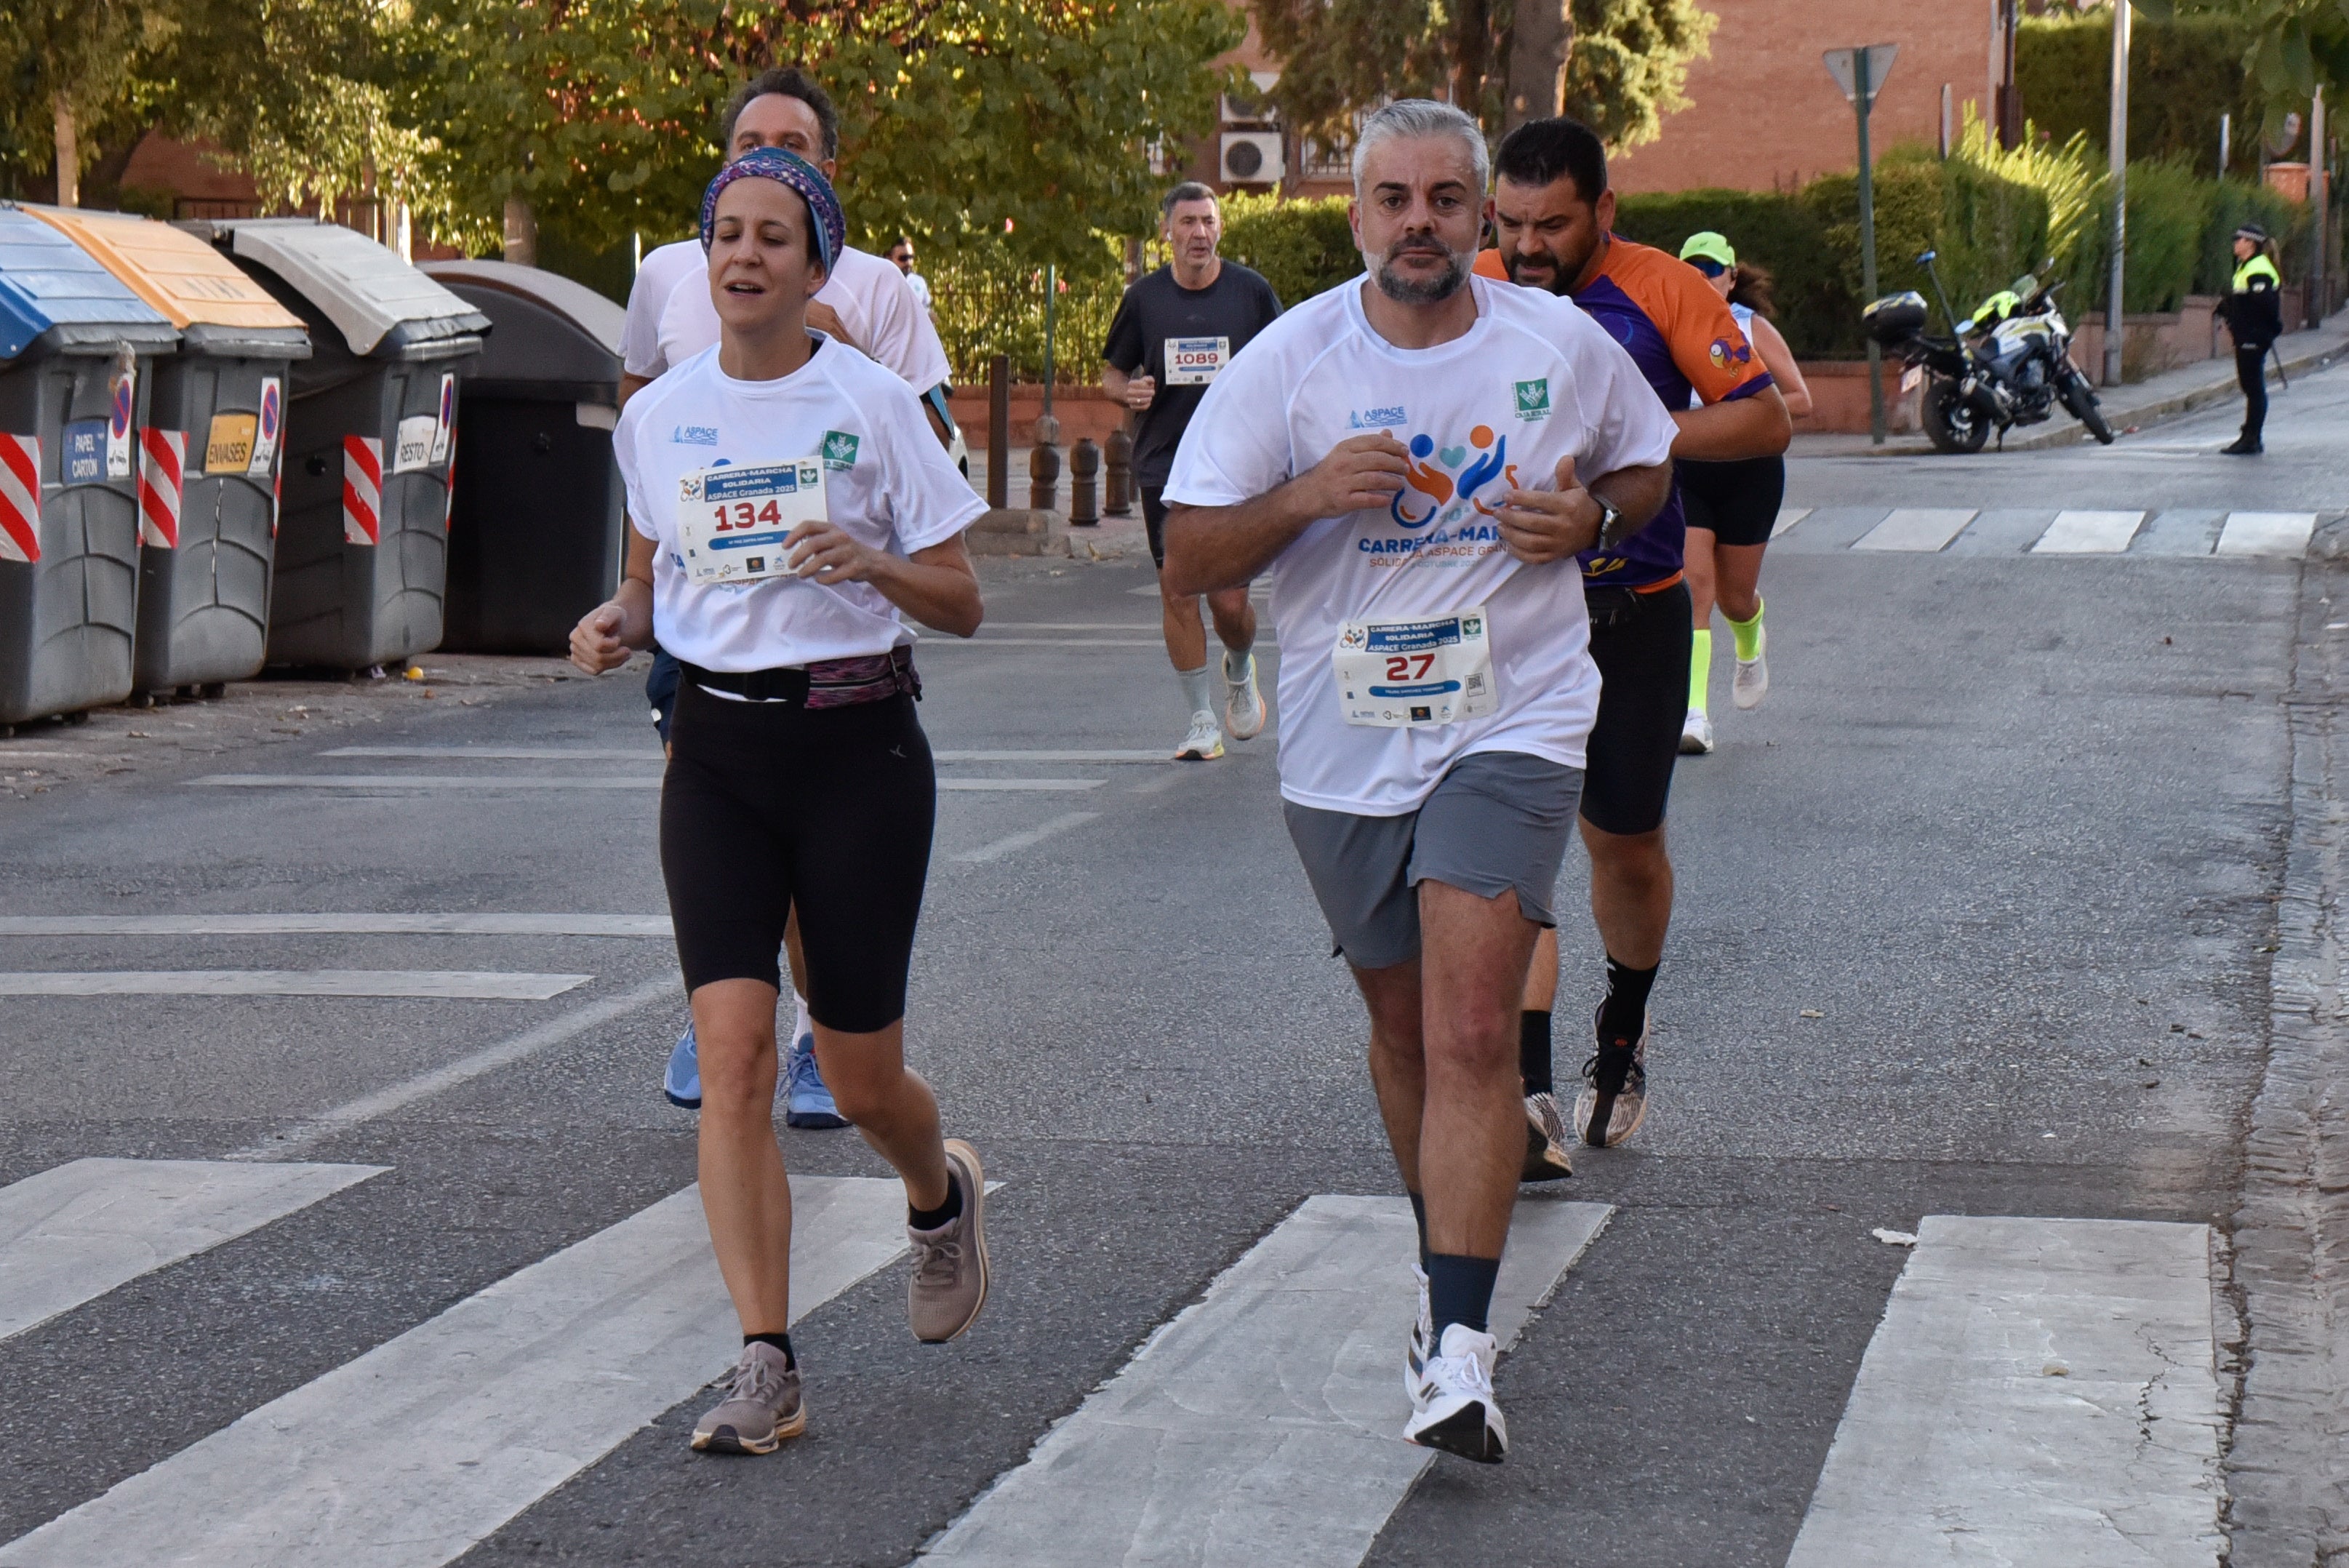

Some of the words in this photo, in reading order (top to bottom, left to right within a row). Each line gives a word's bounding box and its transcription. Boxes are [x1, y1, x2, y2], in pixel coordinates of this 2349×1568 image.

[1175, 353, 1218, 364] 1089
[1364, 407, 1404, 420] ASPACE
[684, 426, 718, 438] ASPACE
[75, 434, 95, 452] PAPEL
[209, 442, 247, 463] ENVASES
[401, 441, 424, 463] RESTO
[72, 454, 97, 478] CARTÓN
[707, 467, 793, 481] CARRERA-MARCHA
[722, 478, 772, 488] SOLIDARIA
[708, 489, 737, 500] ASPACE
[740, 486, 773, 496] Granada
[775, 484, 795, 493] 2025
[714, 500, 782, 532] 134
[1428, 547, 1473, 556] ASPACE
[1370, 620, 1455, 632] CARRERA-MARCHA
[1385, 632, 1434, 641] SOLIDARIA
[1401, 641, 1437, 650] Granada
[1438, 636, 1458, 645] 2025
[1386, 653, 1435, 681] 27
